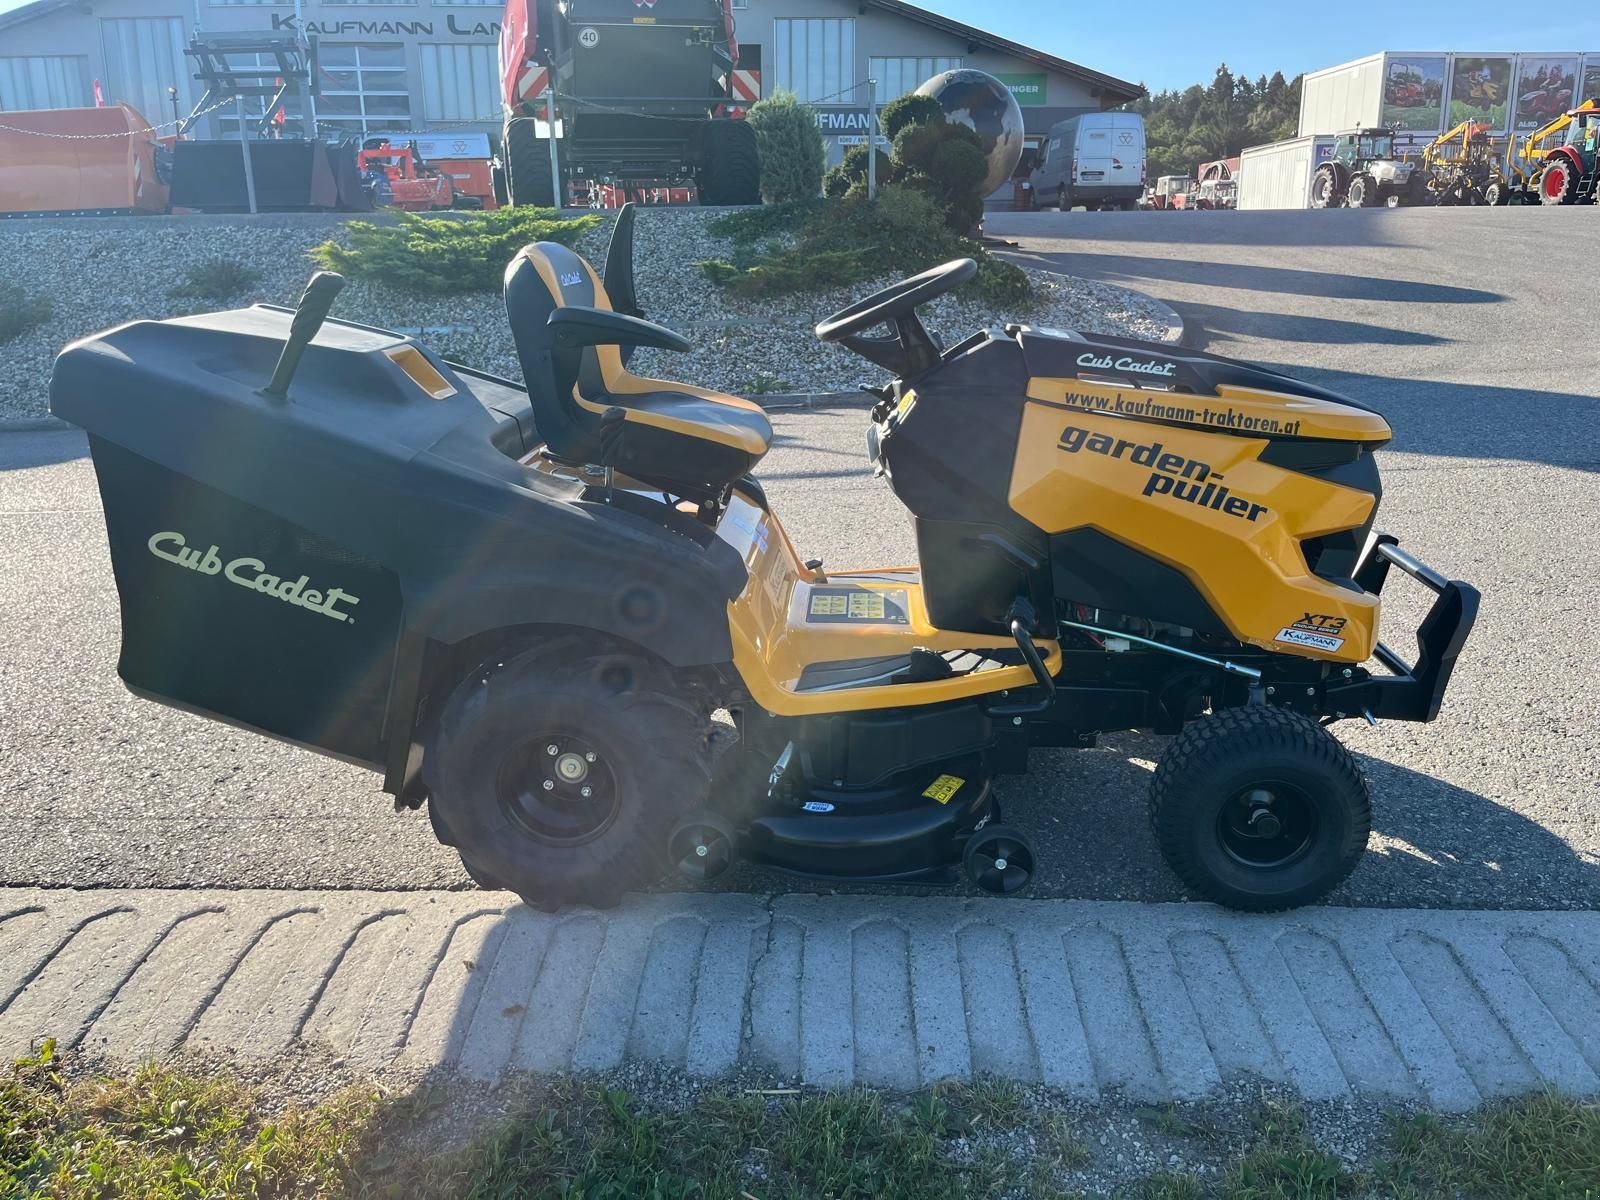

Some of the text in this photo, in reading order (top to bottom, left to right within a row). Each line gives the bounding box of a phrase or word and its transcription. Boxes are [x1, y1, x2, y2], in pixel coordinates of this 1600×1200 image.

[271, 13, 433, 36] KAUFMANN
[582, 32, 596, 42] 40
[1076, 353, 1176, 377] Cub Cadet
[1064, 390, 1301, 436] www.kaufmann-traktoren.at
[1056, 425, 1225, 483] garden-
[1141, 472, 1269, 523] puller
[147, 531, 361, 622] Cub Cadet
[1295, 612, 1348, 629] XT3
[1283, 630, 1336, 646] KAUFMANN
